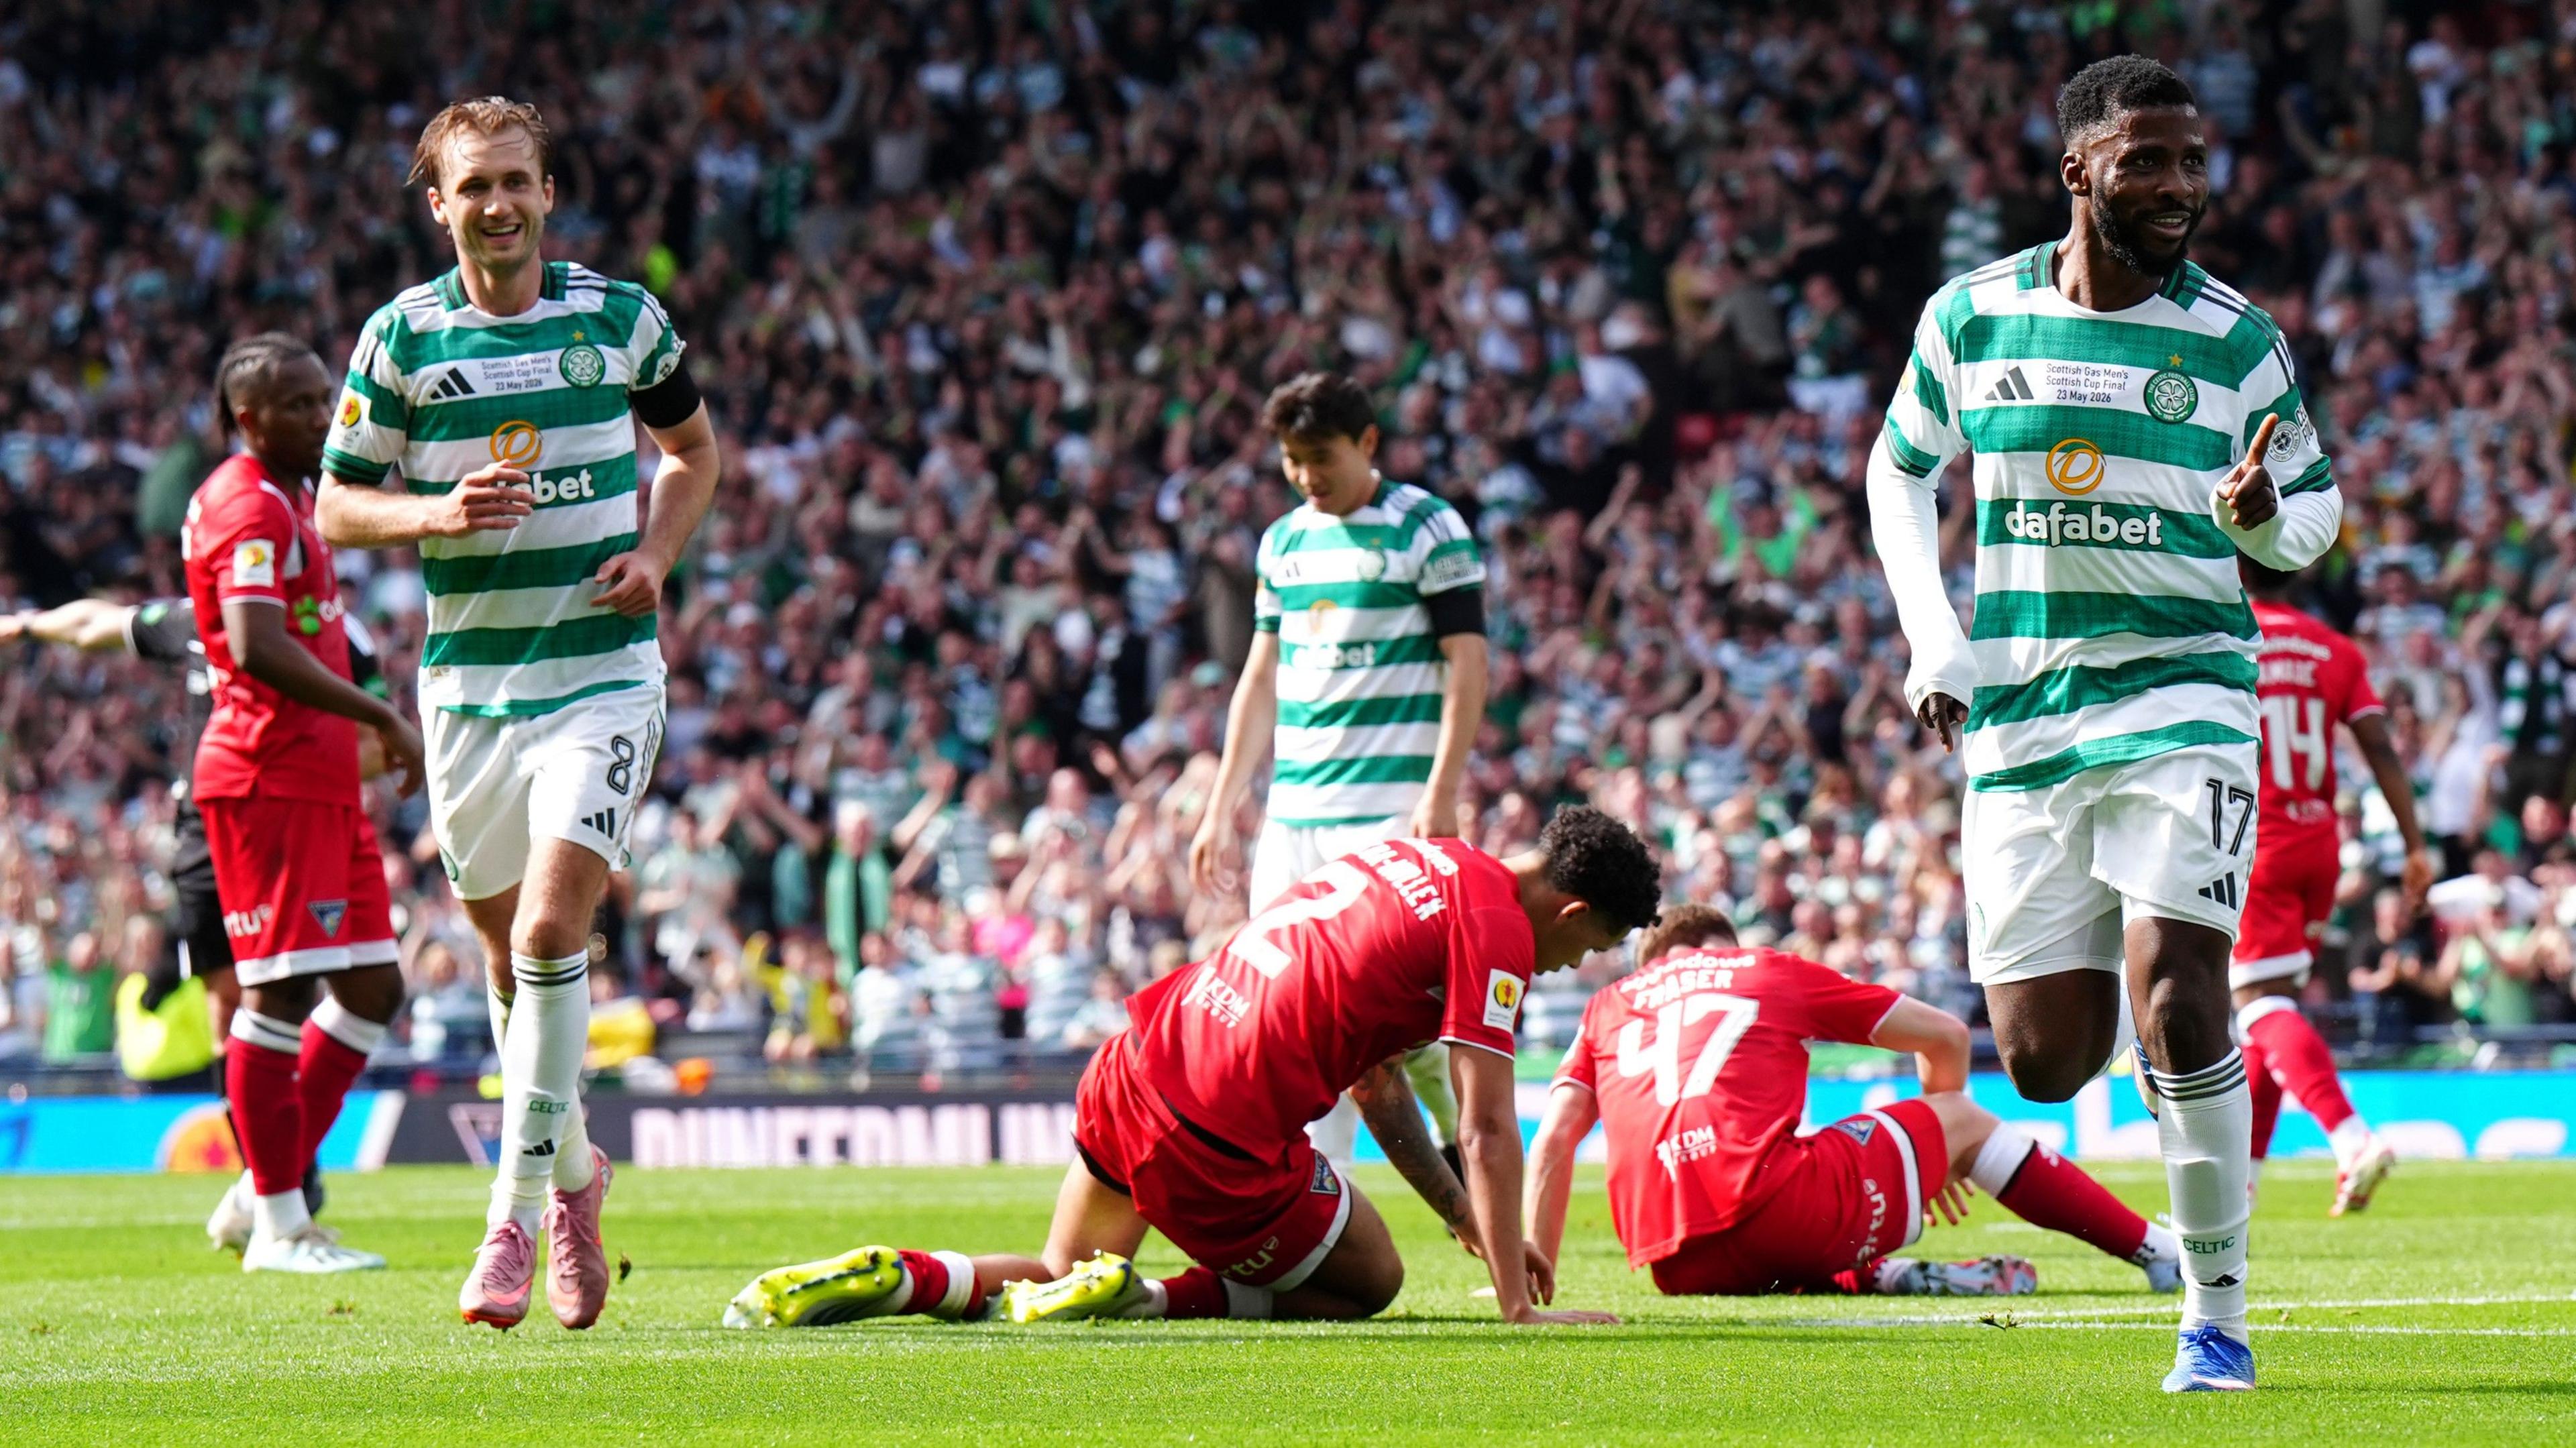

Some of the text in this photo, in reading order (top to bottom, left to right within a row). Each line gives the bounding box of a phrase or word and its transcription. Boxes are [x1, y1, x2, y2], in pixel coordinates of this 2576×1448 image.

[484, 366, 552, 380] Scottish Cup Final
[495, 378, 543, 391] 23 May 2026
[2046, 363, 2129, 380] Scottish Gas Men's
[2046, 375, 2126, 390] Scottish Cup Final
[2057, 389, 2111, 404] 23 May 2026
[2004, 500, 2161, 547] dafabet
[2261, 694, 2326, 791] 14
[607, 735, 635, 795] 8
[2206, 777, 2255, 856] 17
[1227, 860, 1368, 980] 2
[1205, 976, 1250, 1019] KDM
[1633, 969, 1733, 1009] FRASER
[1617, 992, 1760, 1107] 47
[529, 1100, 570, 1114] CELTIC
[2182, 1236, 2235, 1254] CELTIC
